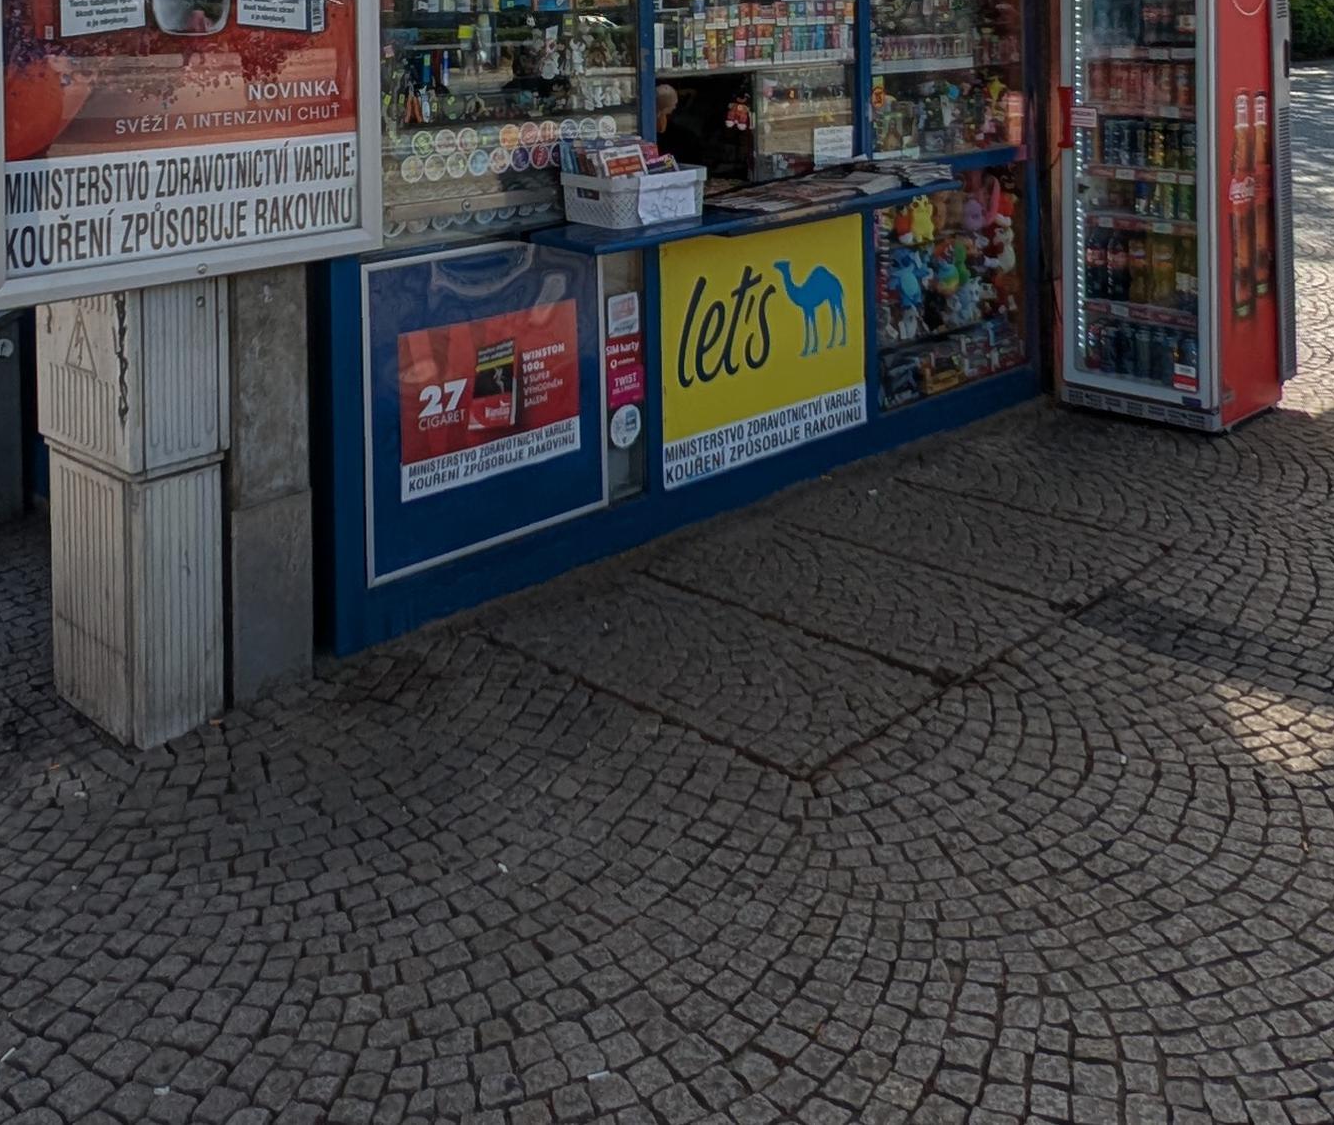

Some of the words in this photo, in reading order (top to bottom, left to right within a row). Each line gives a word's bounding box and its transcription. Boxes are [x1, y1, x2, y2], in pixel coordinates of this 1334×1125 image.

[247, 81, 340, 102] NOVINKA
[115, 114, 169, 136] SVĚŽÍ
[174, 111, 187, 130] A
[192, 104, 293, 129] INTENZIVNÍ
[296, 101, 340, 122] CHUŤ
[5, 159, 149, 216] MINISTERSTVO
[155, 140, 289, 199] ZDRAVOTNICTVÍ
[293, 141, 356, 181] VARUJE:
[5, 207, 116, 271] KOUŘENÍ
[120, 201, 247, 254] ZPŮSOBUJE
[254, 187, 353, 235] RAKOVINU
[677, 264, 777, 389] let's
[522, 342, 565, 362] WINSTON
[620, 340, 640, 354] karty
[522, 361, 544, 373] 100s
[614, 372, 638, 388] TWIST
[418, 379, 467, 418] 27
[418, 408, 466, 431] CIGARET
[664, 425, 746, 464] MINISTERSTVO
[747, 398, 823, 441] ZDRAVOTNICTVÍ
[825, 388, 862, 414] VARUJE:
[408, 451, 478, 480] MINISTERSTVO
[479, 428, 544, 463] ZDRAVOTNICTVÍ
[408, 466, 460, 494] KOUŘENÍ
[463, 447, 525, 480] ZPŮSOBUJE
[527, 433, 577, 459] RAKOVINU
[665, 447, 728, 485] KOUŘENÍ
[729, 429, 801, 463] ZPŮSOBUJE
[804, 407, 863, 439] RAKOVINU
